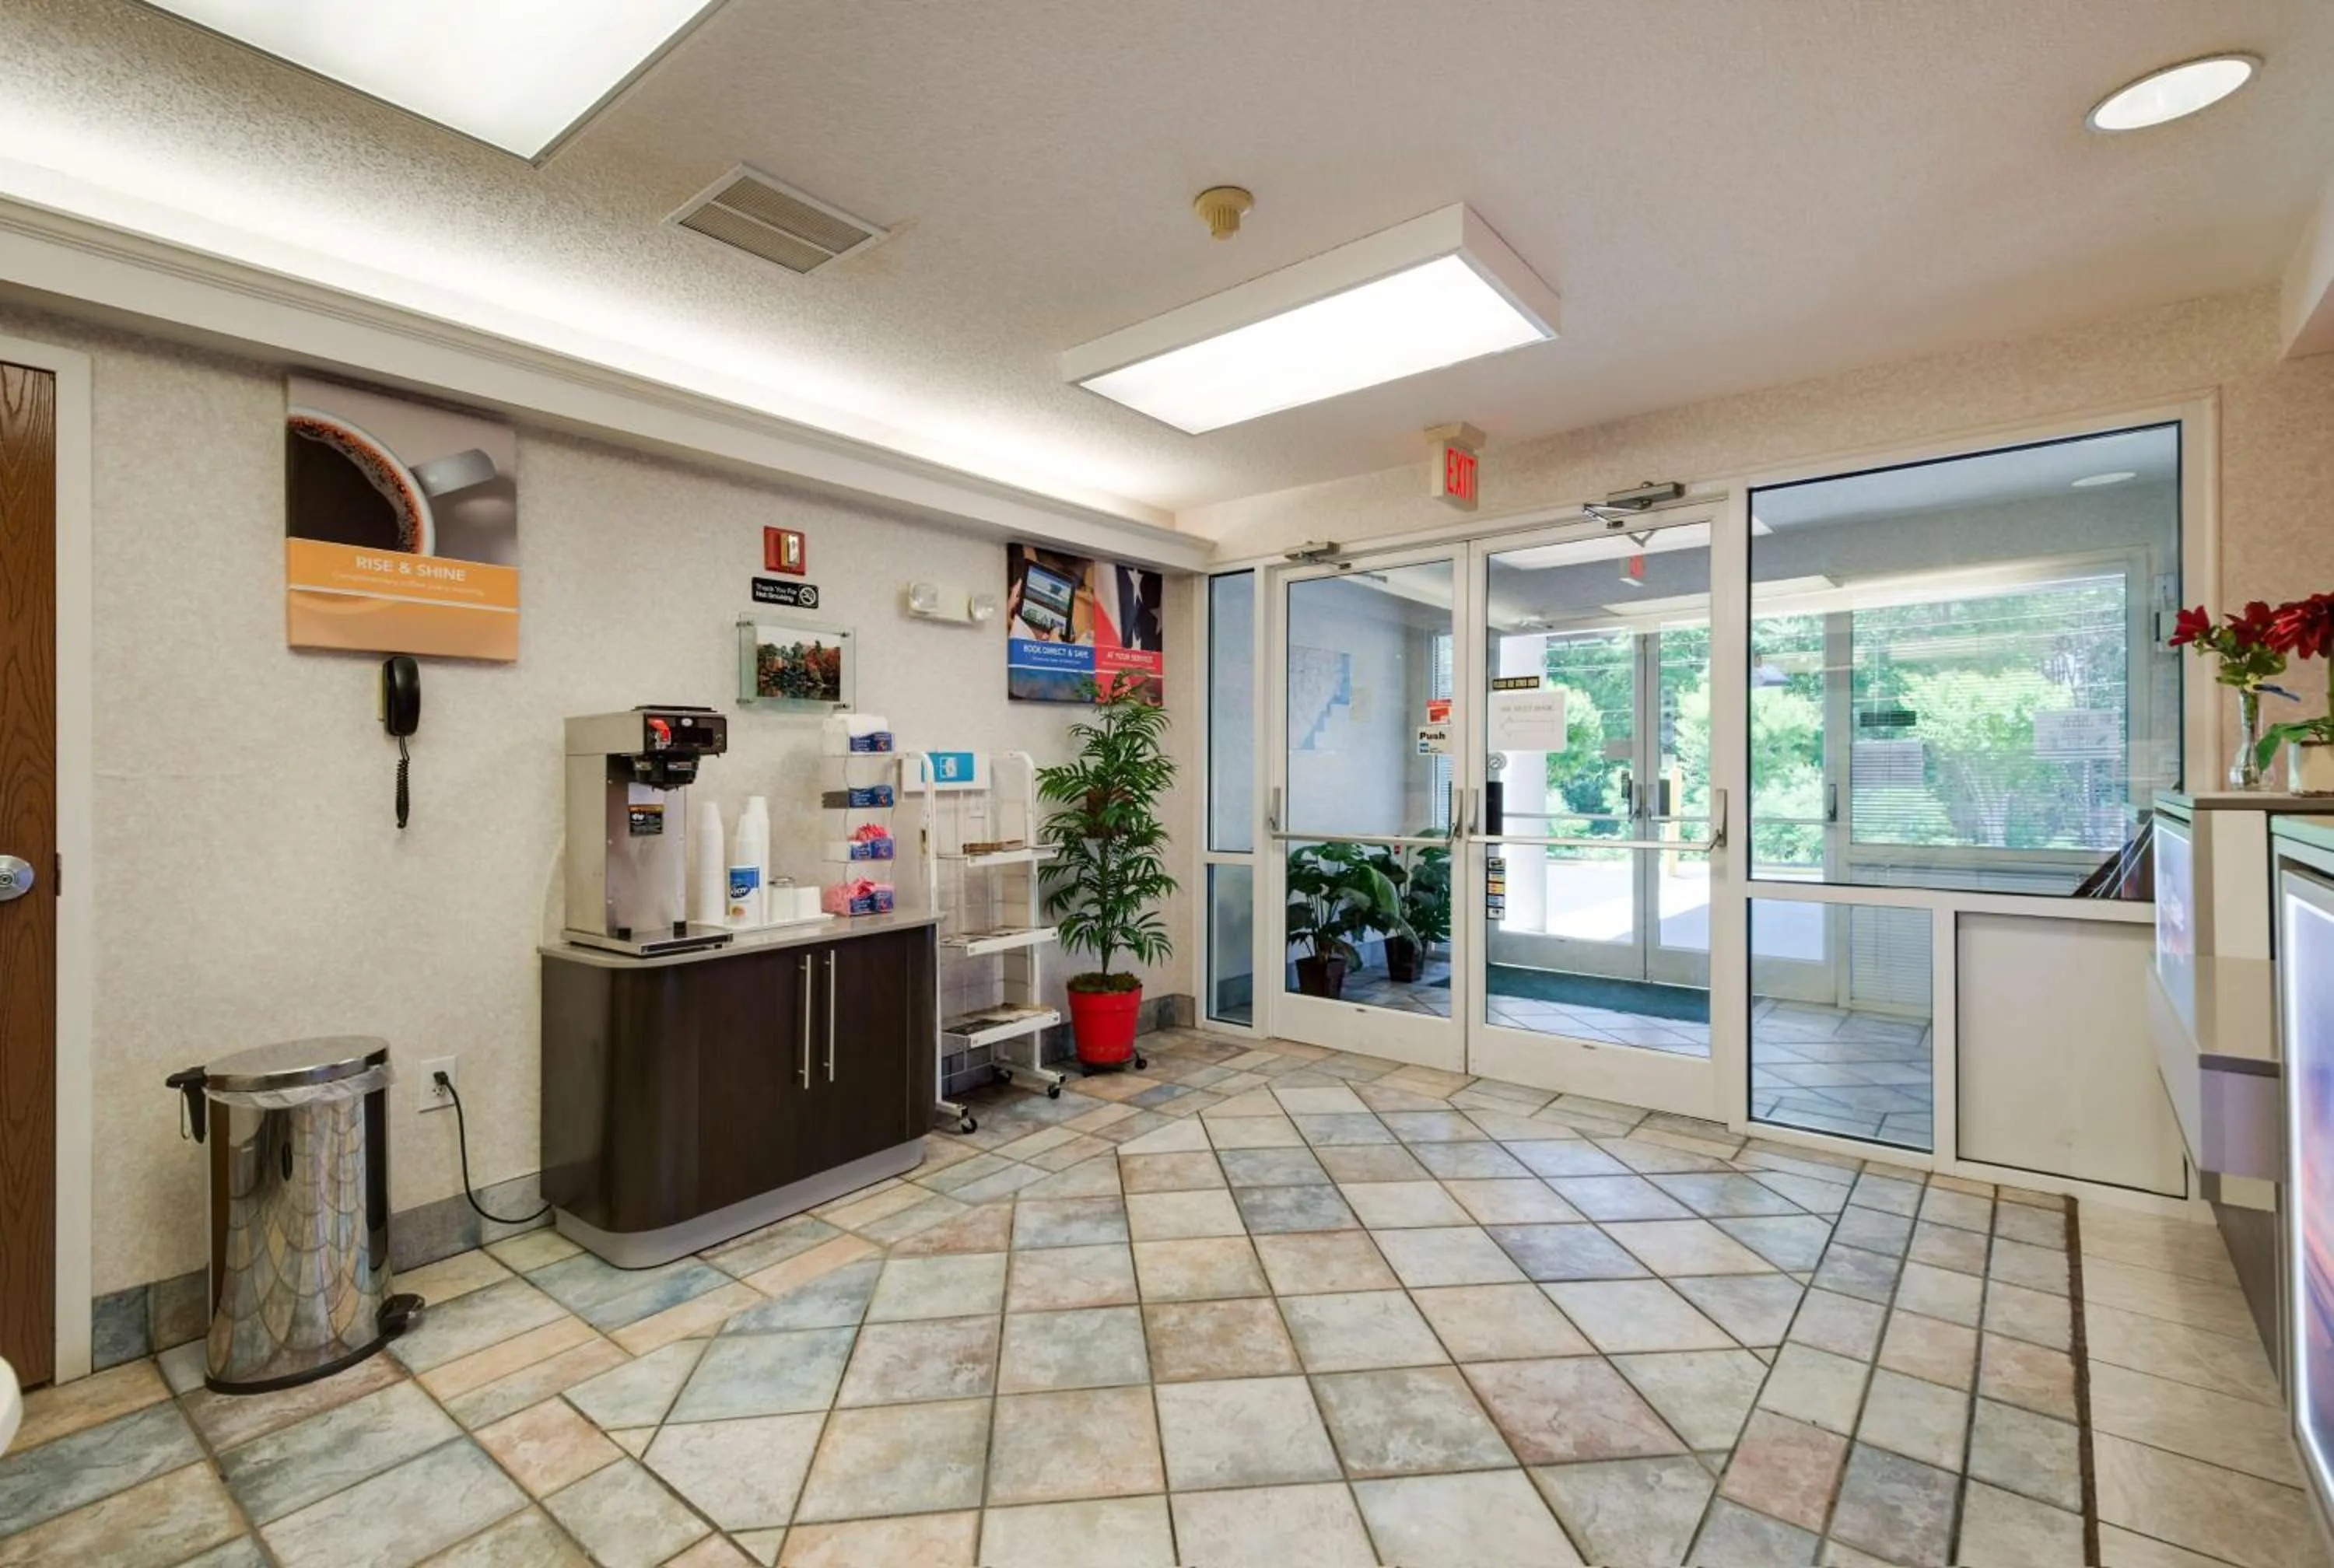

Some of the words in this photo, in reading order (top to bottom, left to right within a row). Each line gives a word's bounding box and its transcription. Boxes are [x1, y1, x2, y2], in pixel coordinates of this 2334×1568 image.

[1446, 447, 1476, 501] EXIT
[356, 555, 394, 572] RISE
[398, 561, 412, 574] &
[416, 564, 466, 582] SHINE
[1023, 644, 1042, 654] BOOK
[1419, 731, 1446, 740] Push
